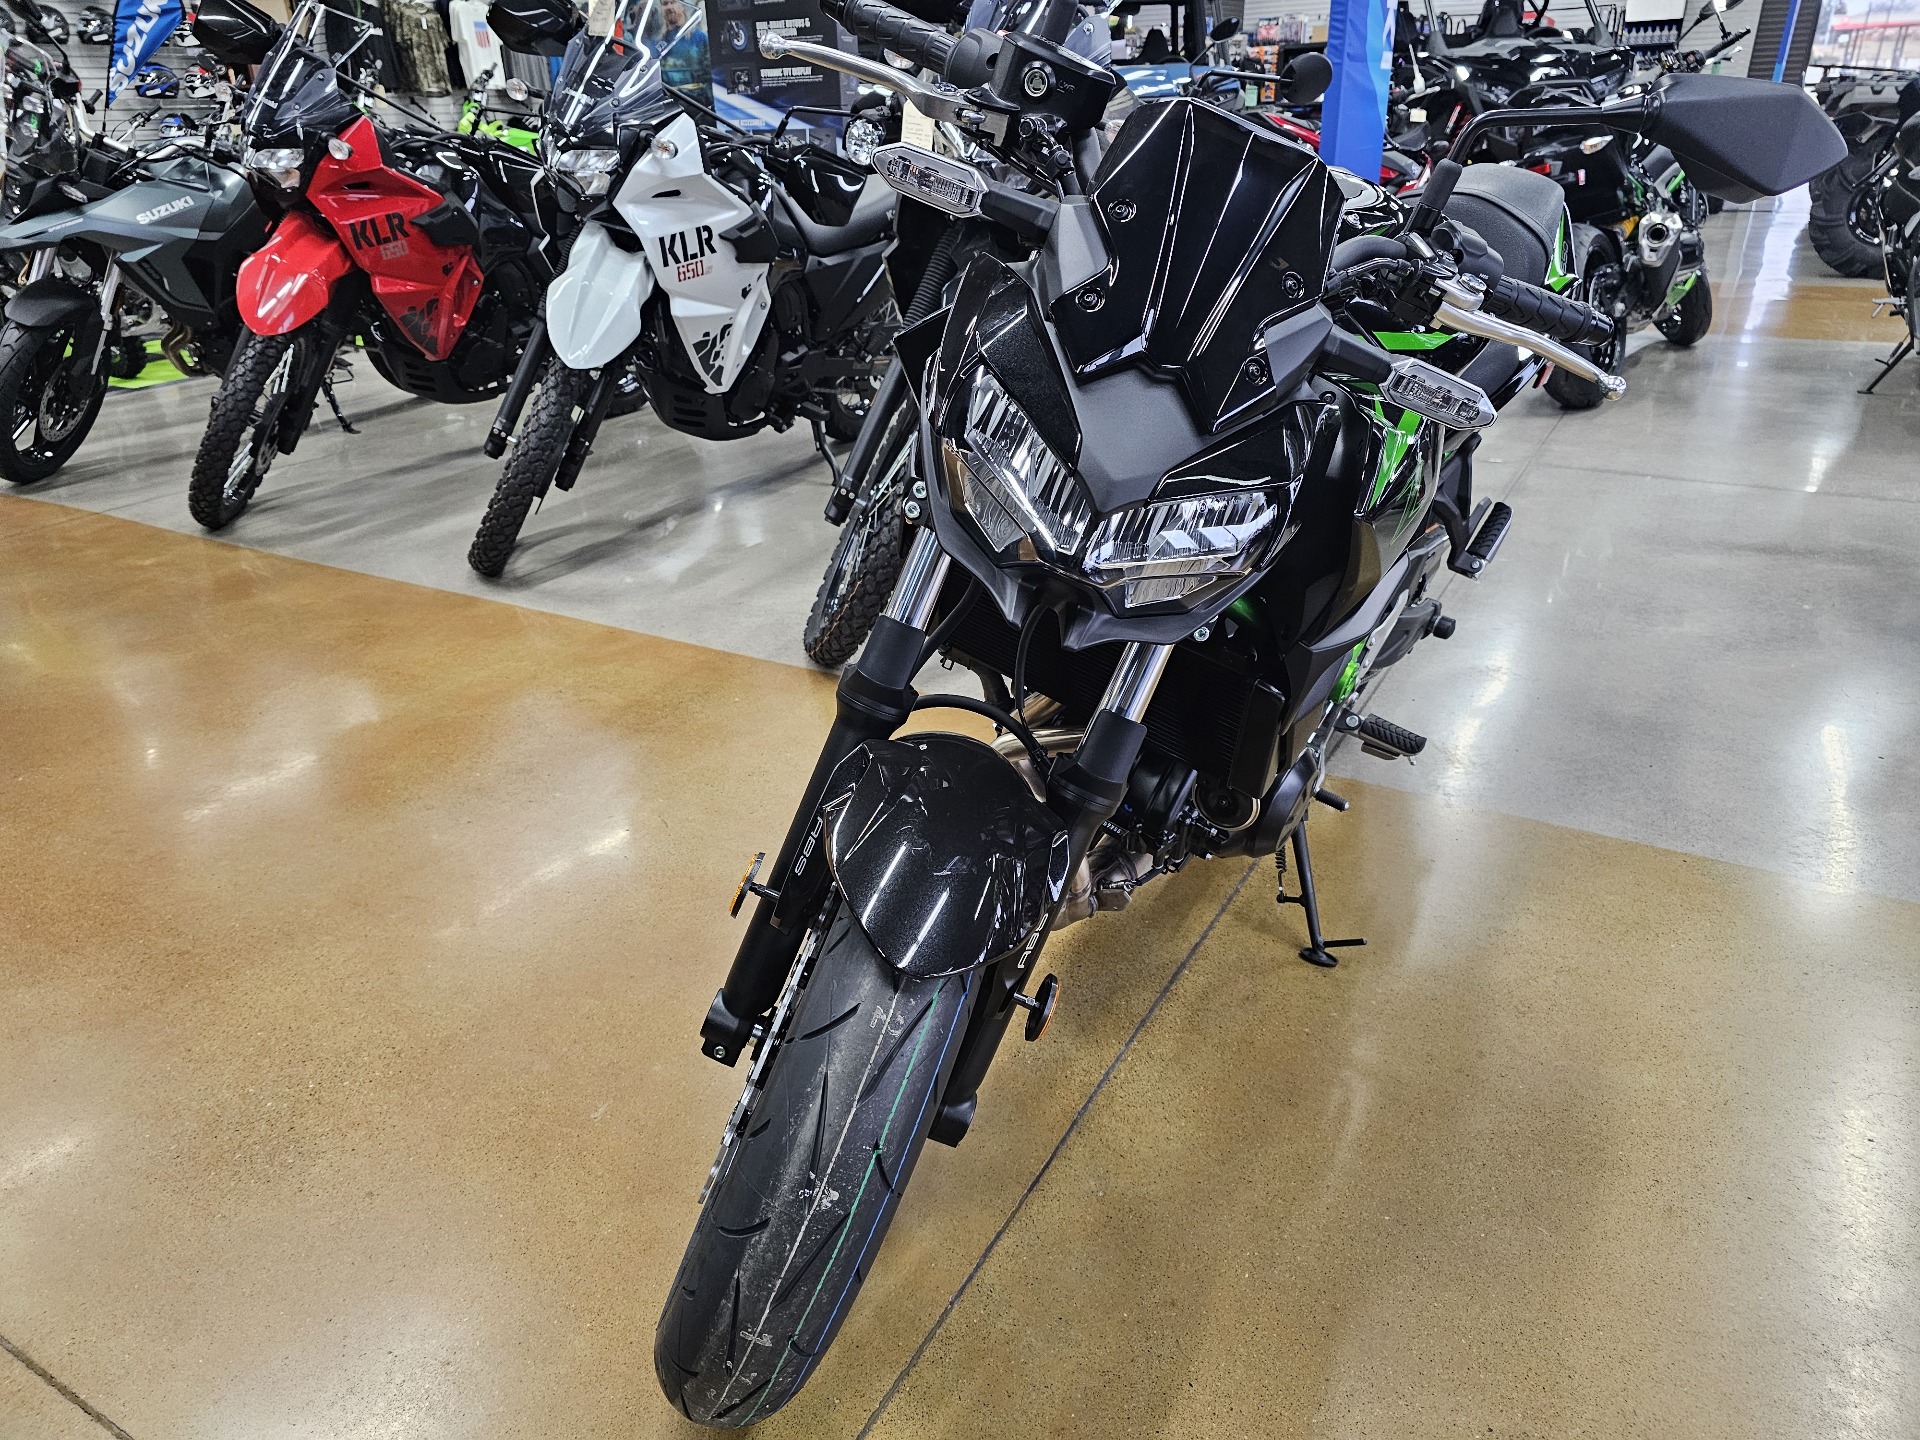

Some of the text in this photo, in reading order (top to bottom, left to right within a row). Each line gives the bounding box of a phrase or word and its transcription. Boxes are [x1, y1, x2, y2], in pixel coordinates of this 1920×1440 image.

[135, 195, 195, 225] SUZUKI
[349, 211, 411, 250] KLR
[658, 224, 718, 268] KLR
[676, 259, 705, 283] 650
[794, 815, 824, 877] ABS
